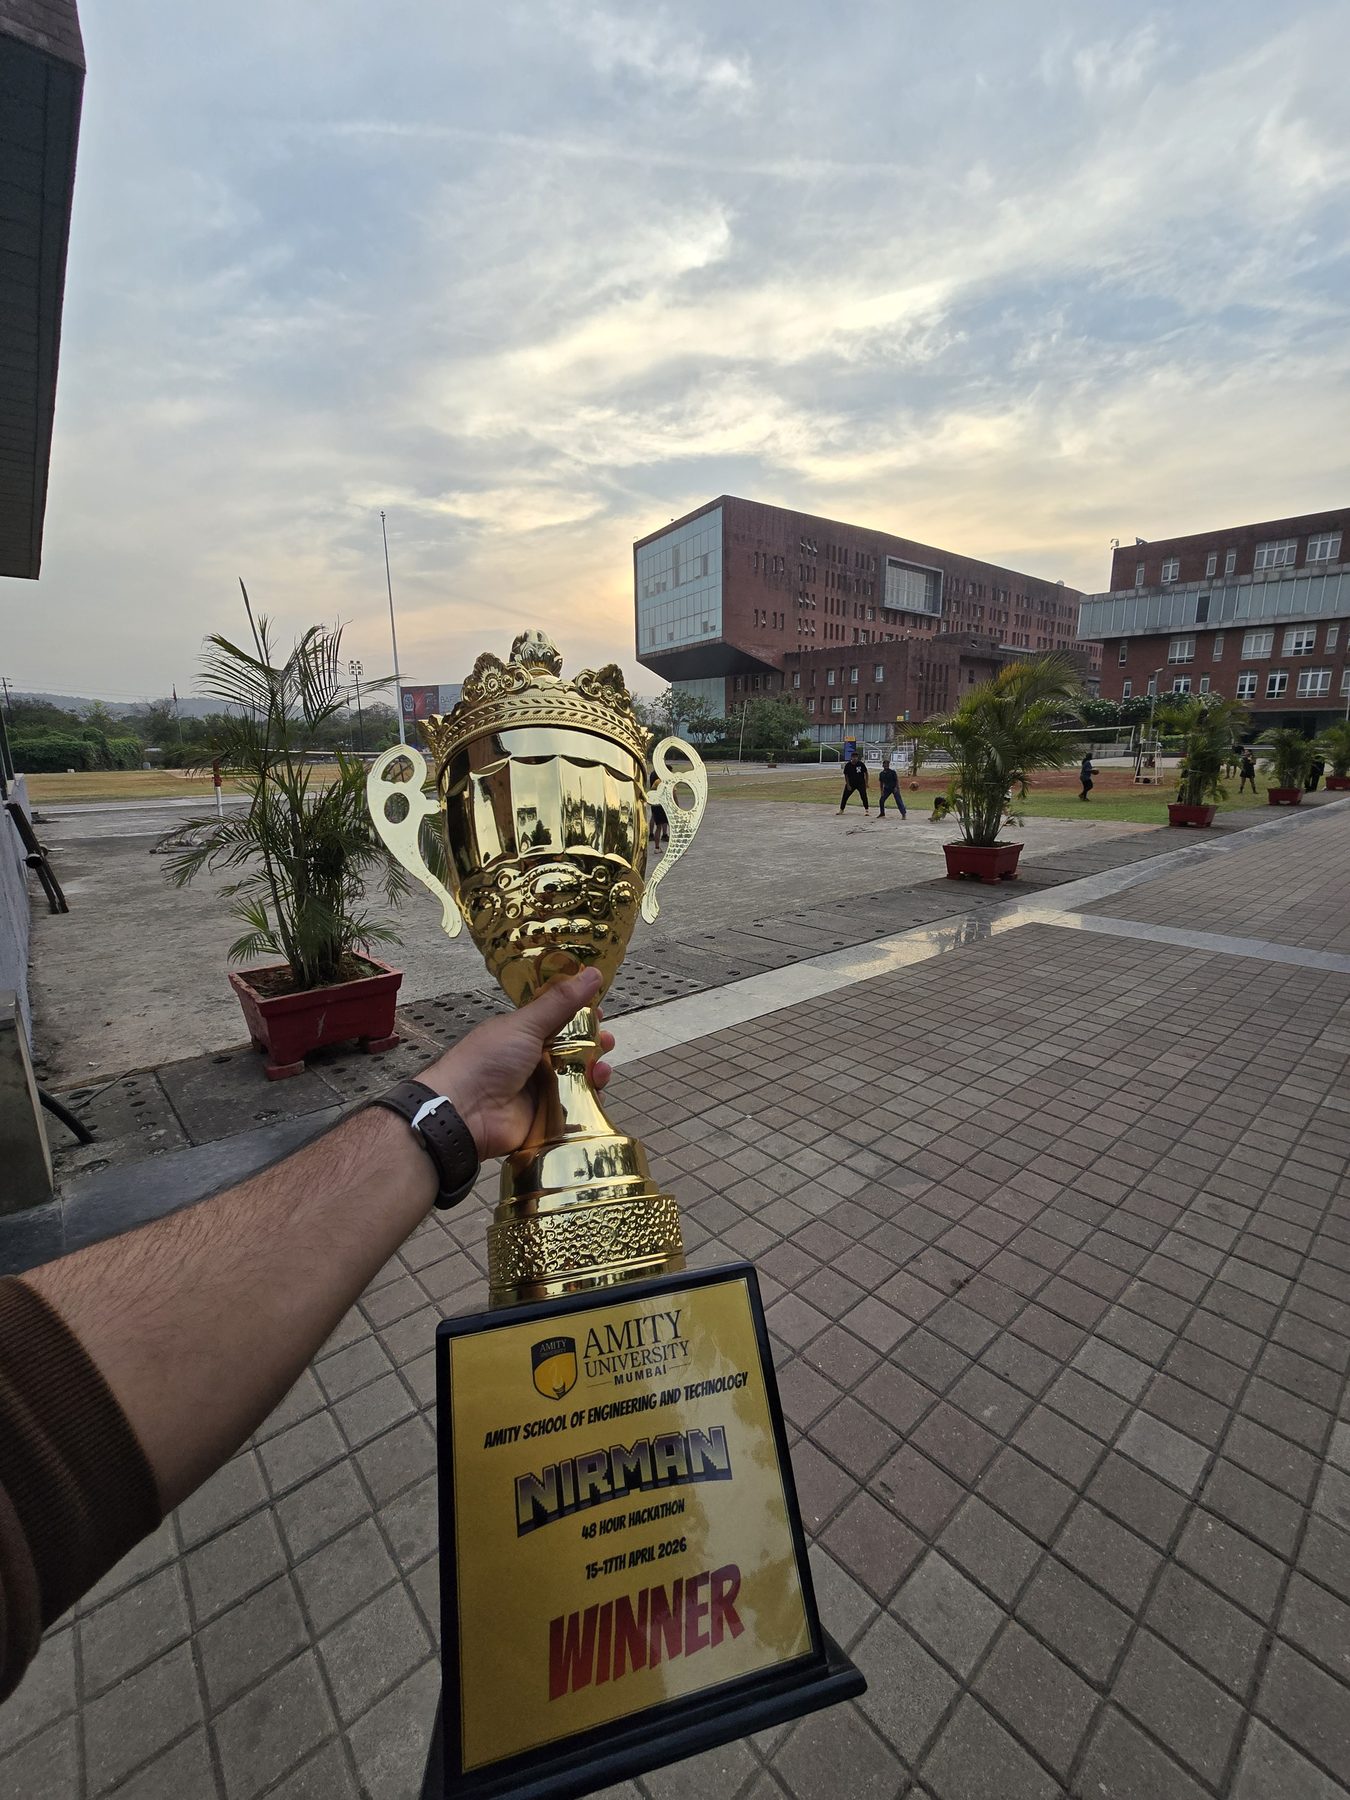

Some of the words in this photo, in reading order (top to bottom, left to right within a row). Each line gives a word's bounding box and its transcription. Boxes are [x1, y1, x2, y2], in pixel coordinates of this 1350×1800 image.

[540, 1339, 567, 1352] AMITY
[583, 1309, 682, 1359] AMITY
[584, 1340, 690, 1378] UNIVERSITY
[614, 1364, 667, 1386] MUMBAI
[484, 1426, 521, 1449] AMITY
[523, 1414, 568, 1440] SCHOOL
[570, 1410, 586, 1428] OF
[587, 1393, 657, 1424] ENGINEERING
[659, 1388, 682, 1407] AND
[684, 1371, 749, 1401] TECHNOLOGY
[514, 1425, 733, 1538] NIRMAN
[581, 1522, 597, 1540] 48
[599, 1515, 626, 1536] HOUR
[628, 1498, 685, 1528] HACKATHON
[585, 1554, 627, 1580] 15-17TH
[628, 1545, 656, 1568] APRIL
[658, 1536, 687, 1559] 2026
[548, 1563, 746, 1701] WINNER
